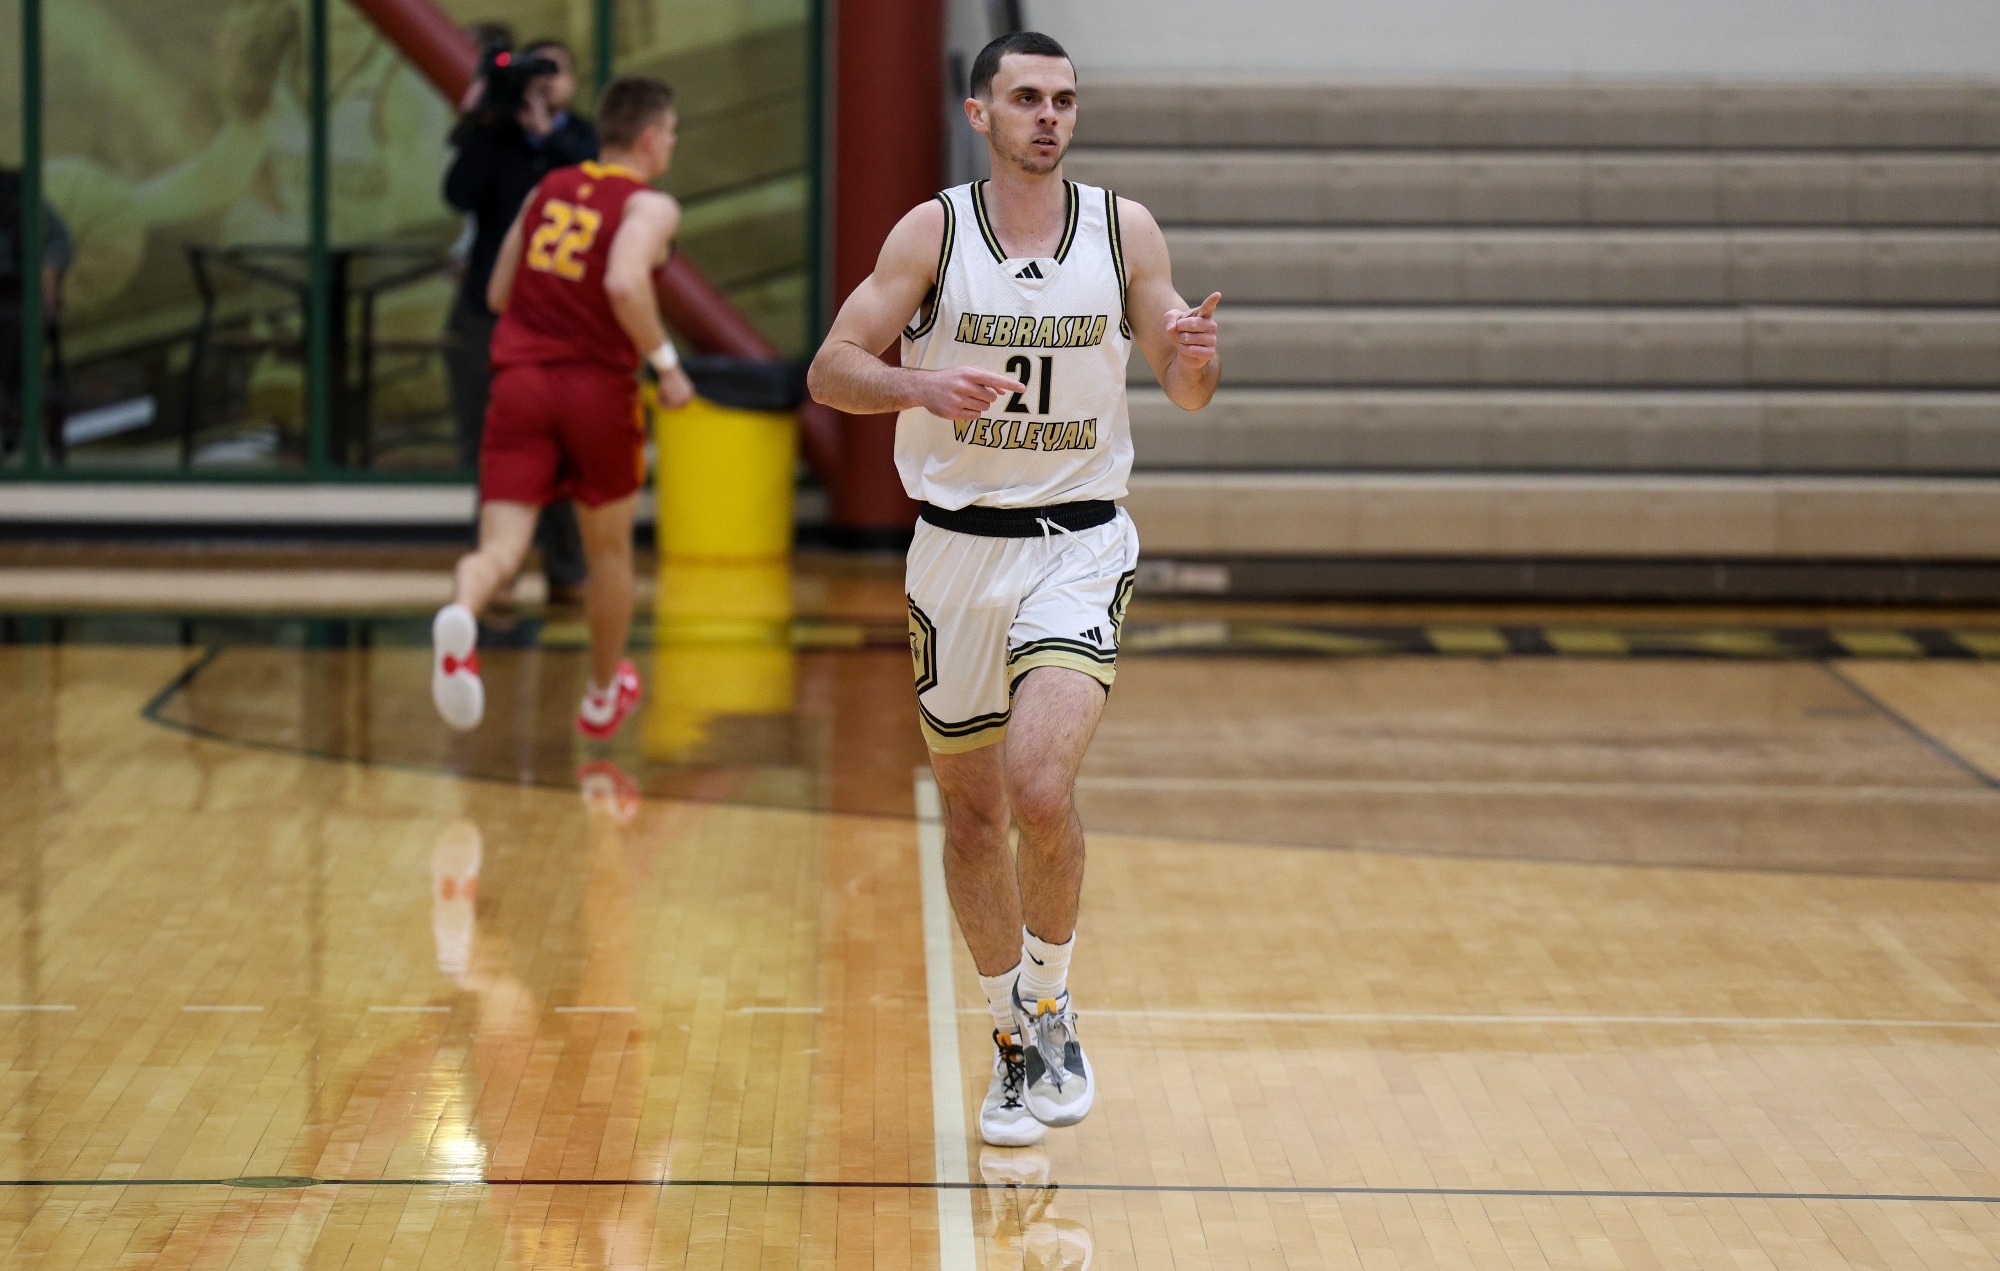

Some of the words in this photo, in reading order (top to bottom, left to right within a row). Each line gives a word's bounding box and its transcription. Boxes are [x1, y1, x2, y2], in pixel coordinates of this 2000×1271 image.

[528, 199, 601, 280] 22
[955, 312, 1108, 348] NEBRASKA
[1004, 354, 1053, 415] 21
[953, 418, 1097, 451] WESLEYAN
